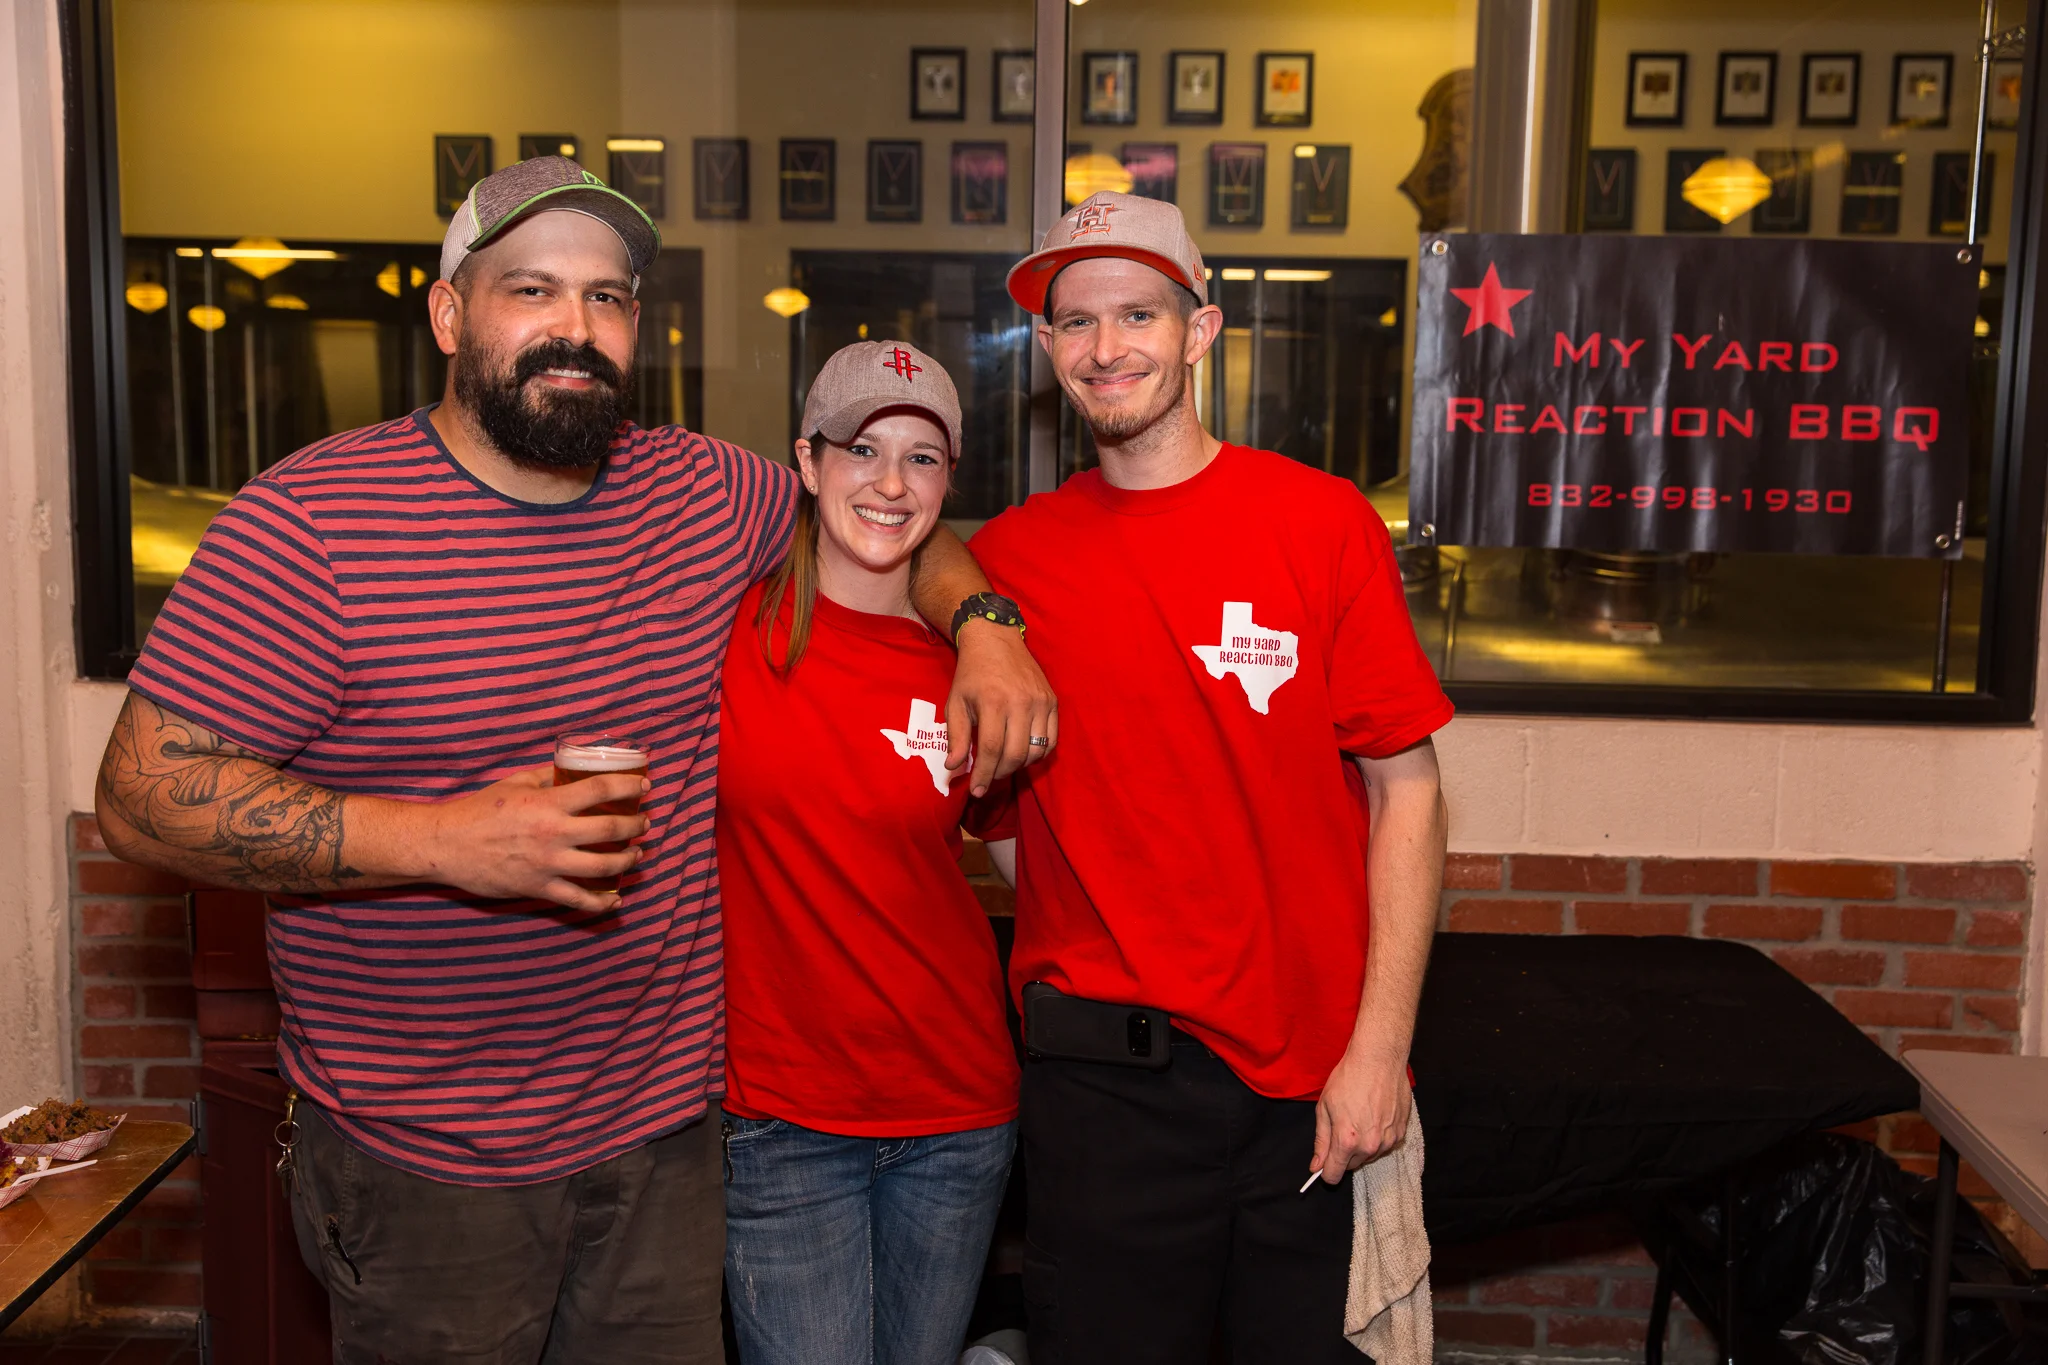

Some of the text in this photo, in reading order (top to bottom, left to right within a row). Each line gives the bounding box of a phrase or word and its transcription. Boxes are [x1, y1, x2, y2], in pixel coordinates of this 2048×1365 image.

[1788, 403, 1941, 452] BBQ
[1526, 483, 1853, 514] 832-998-1930
[906, 738, 947, 752] Reactio
